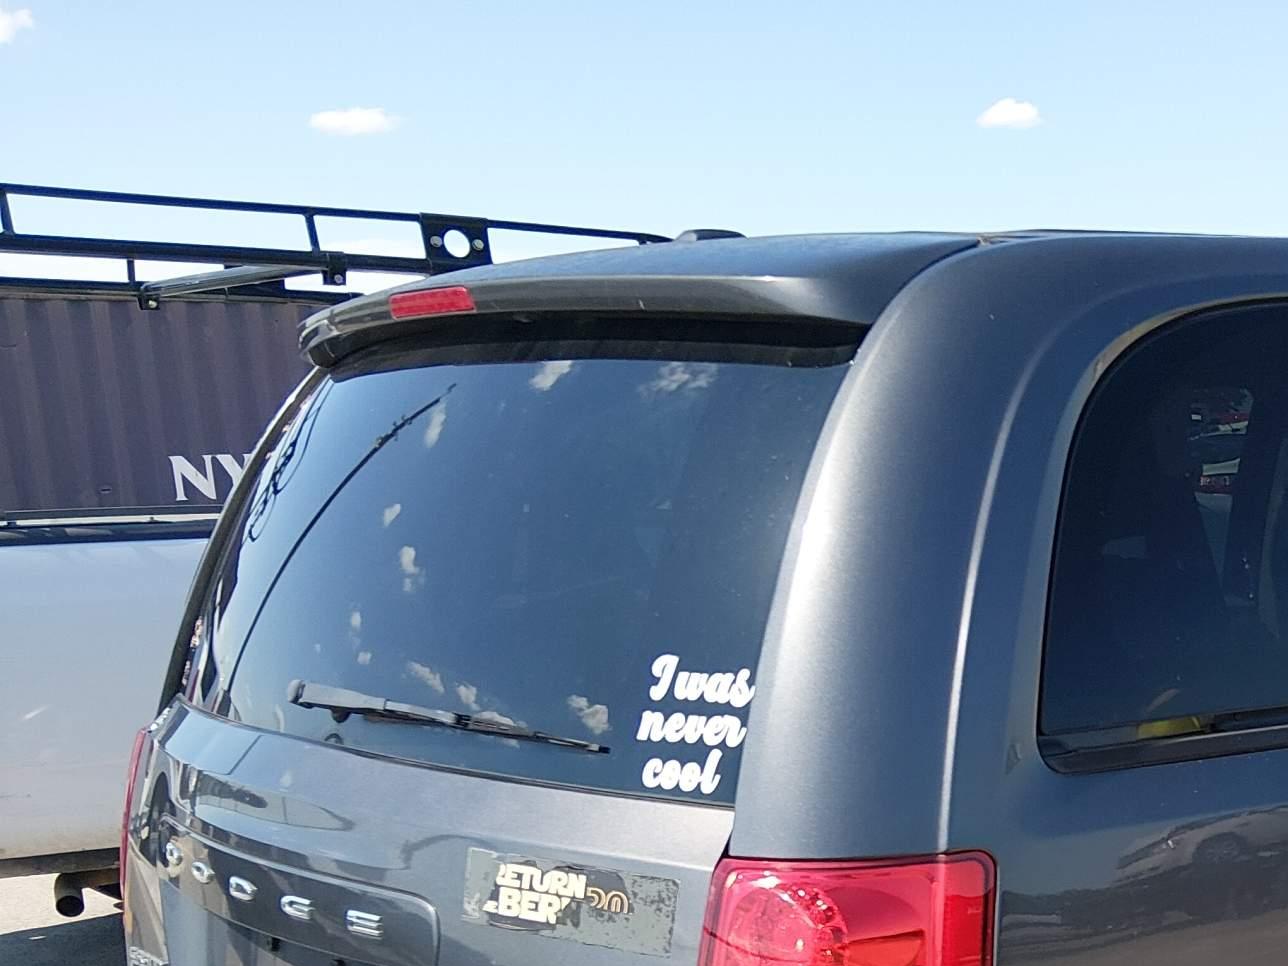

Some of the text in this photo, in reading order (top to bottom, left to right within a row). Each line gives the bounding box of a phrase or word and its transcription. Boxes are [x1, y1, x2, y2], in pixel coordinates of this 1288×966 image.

[649, 654, 756, 708] I was
[636, 710, 747, 748] never
[642, 748, 723, 794] cool
[498, 886, 571, 925] BER
